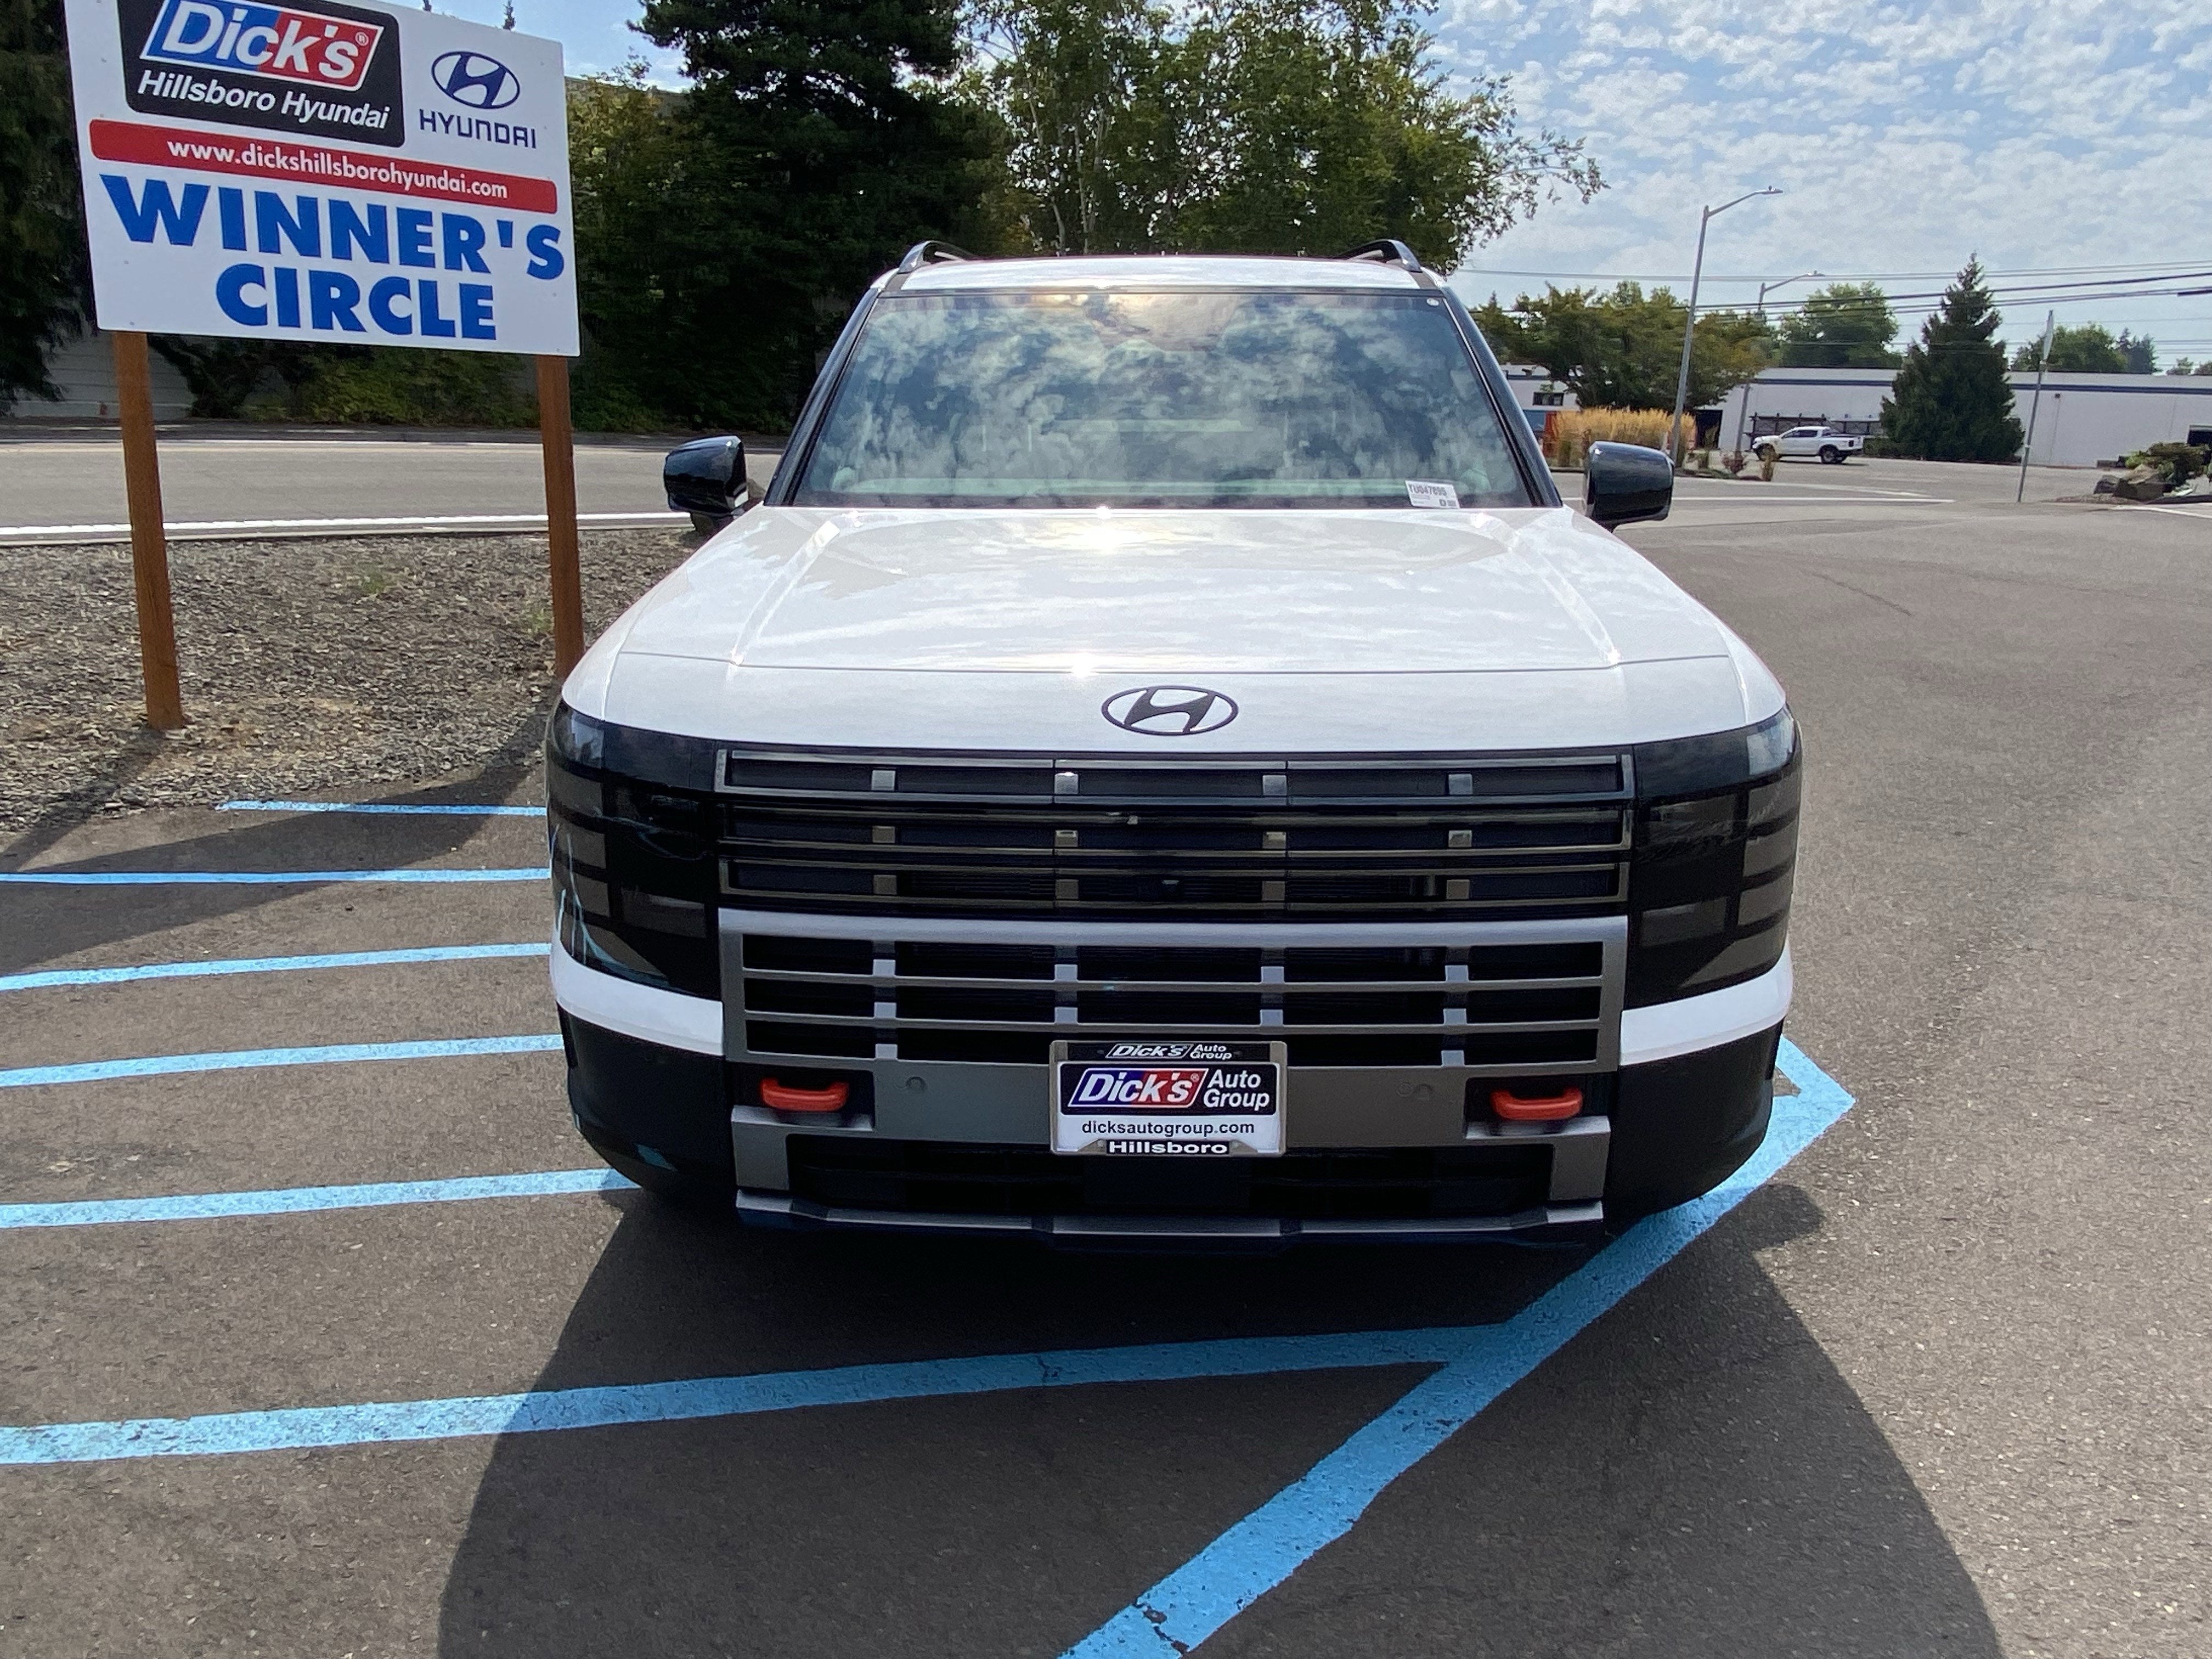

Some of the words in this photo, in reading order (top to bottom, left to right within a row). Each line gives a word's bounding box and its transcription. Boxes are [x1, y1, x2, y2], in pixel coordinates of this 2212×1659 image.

[162, 0, 359, 79] Dick's
[137, 69, 275, 111] Hillsboro
[281, 91, 390, 129] Hyundai
[419, 109, 537, 149] HYUNDAI
[167, 140, 507, 199] www.dickshillsborohyundai.com
[100, 174, 565, 280] WINNER'S
[216, 263, 496, 340] CIRCLE
[1189, 1051, 1232, 1060] Group
[1194, 1043, 1227, 1052] Auto
[1078, 1071, 1193, 1103] Dick's
[1207, 1069, 1261, 1088] Auto
[1203, 1088, 1269, 1111] Group
[1081, 1120, 1255, 1137] dicksautogroup.com
[1109, 1141, 1228, 1154] Hillsboro
